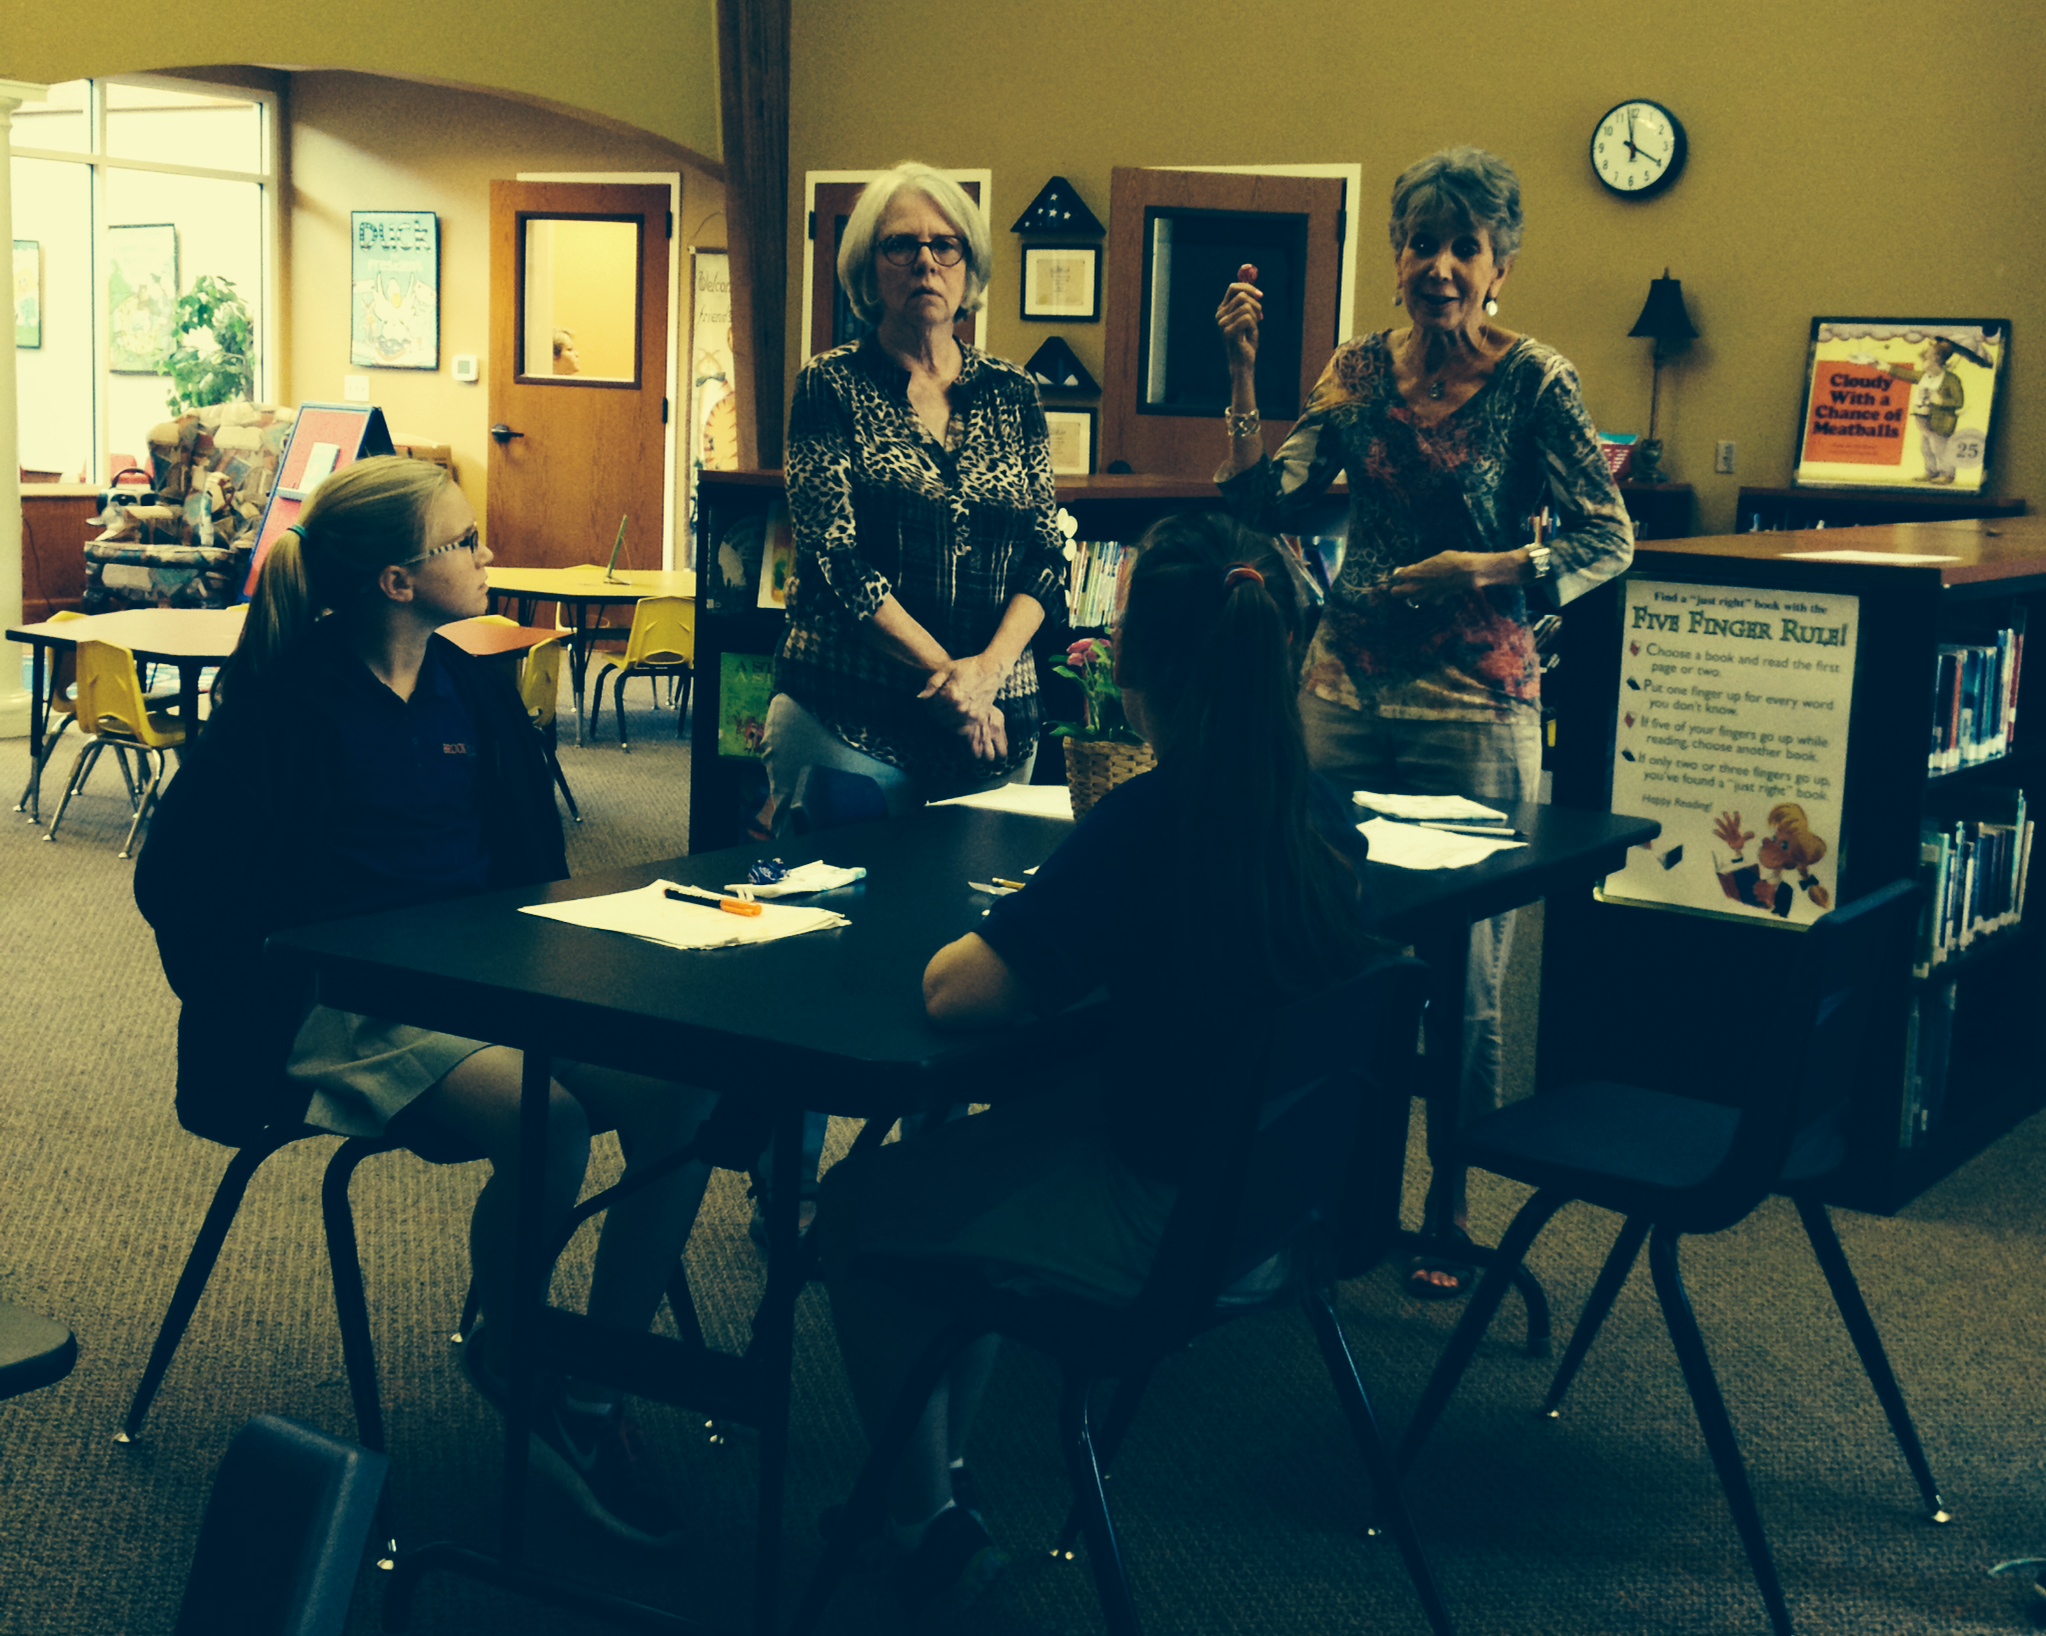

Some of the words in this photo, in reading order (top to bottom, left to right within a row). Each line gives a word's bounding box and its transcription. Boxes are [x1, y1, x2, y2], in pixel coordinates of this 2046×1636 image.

[1830, 373, 1893, 392] Cloudy
[1830, 390, 1876, 406] With
[1880, 395, 1890, 406] a
[1815, 405, 1880, 421] Chance
[1884, 407, 1903, 422] of
[1812, 421, 1900, 438] Meatballs
[1956, 443, 1979, 459] 25
[1655, 591, 1678, 603] Find
[1754, 599, 1780, 611] book
[1784, 602, 1807, 612] with
[1810, 604, 1828, 614] the
[1646, 642, 1691, 659] Choose
[1695, 652, 1702, 660] a
[1705, 649, 1734, 663] book
[1738, 655, 1759, 666] and
[1763, 657, 1788, 669] read
[1793, 659, 1812, 671] the
[1816, 659, 1840, 673] first
[1652, 663, 1677, 676] page
[1681, 666, 1693, 674] or
[1643, 678, 1663, 692] Put
[1666, 686, 1687, 695] one
[1691, 685, 1722, 701] finger
[1727, 691, 1741, 703] up
[1745, 691, 1762, 703] for
[1766, 697, 1798, 710] every
[1803, 700, 1834, 711] word
[1650, 700, 1669, 709] you
[1673, 700, 1702, 712] don't
[1641, 715, 1649, 728] If
[1651, 717, 1670, 730] five
[1674, 721, 1687, 732] of
[1689, 725, 1715, 735] your
[1719, 725, 1756, 741] fingers
[1760, 733, 1774, 744] go
[1778, 735, 1793, 746] up
[1797, 735, 1828, 748] while
[1692, 739, 1732, 752] choose
[1736, 745, 1781, 758] another
[1638, 752, 1646, 763] If
[1649, 756, 1672, 774] only
[1676, 760, 1698, 770] two
[1702, 763, 1714, 771] or
[1719, 764, 1749, 776] three
[1753, 766, 1791, 782] fingers
[1795, 774, 1809, 785] go
[1683, 773, 1715, 787] found
[1719, 780, 1725, 788] a
[1641, 794, 1672, 808] Happy
